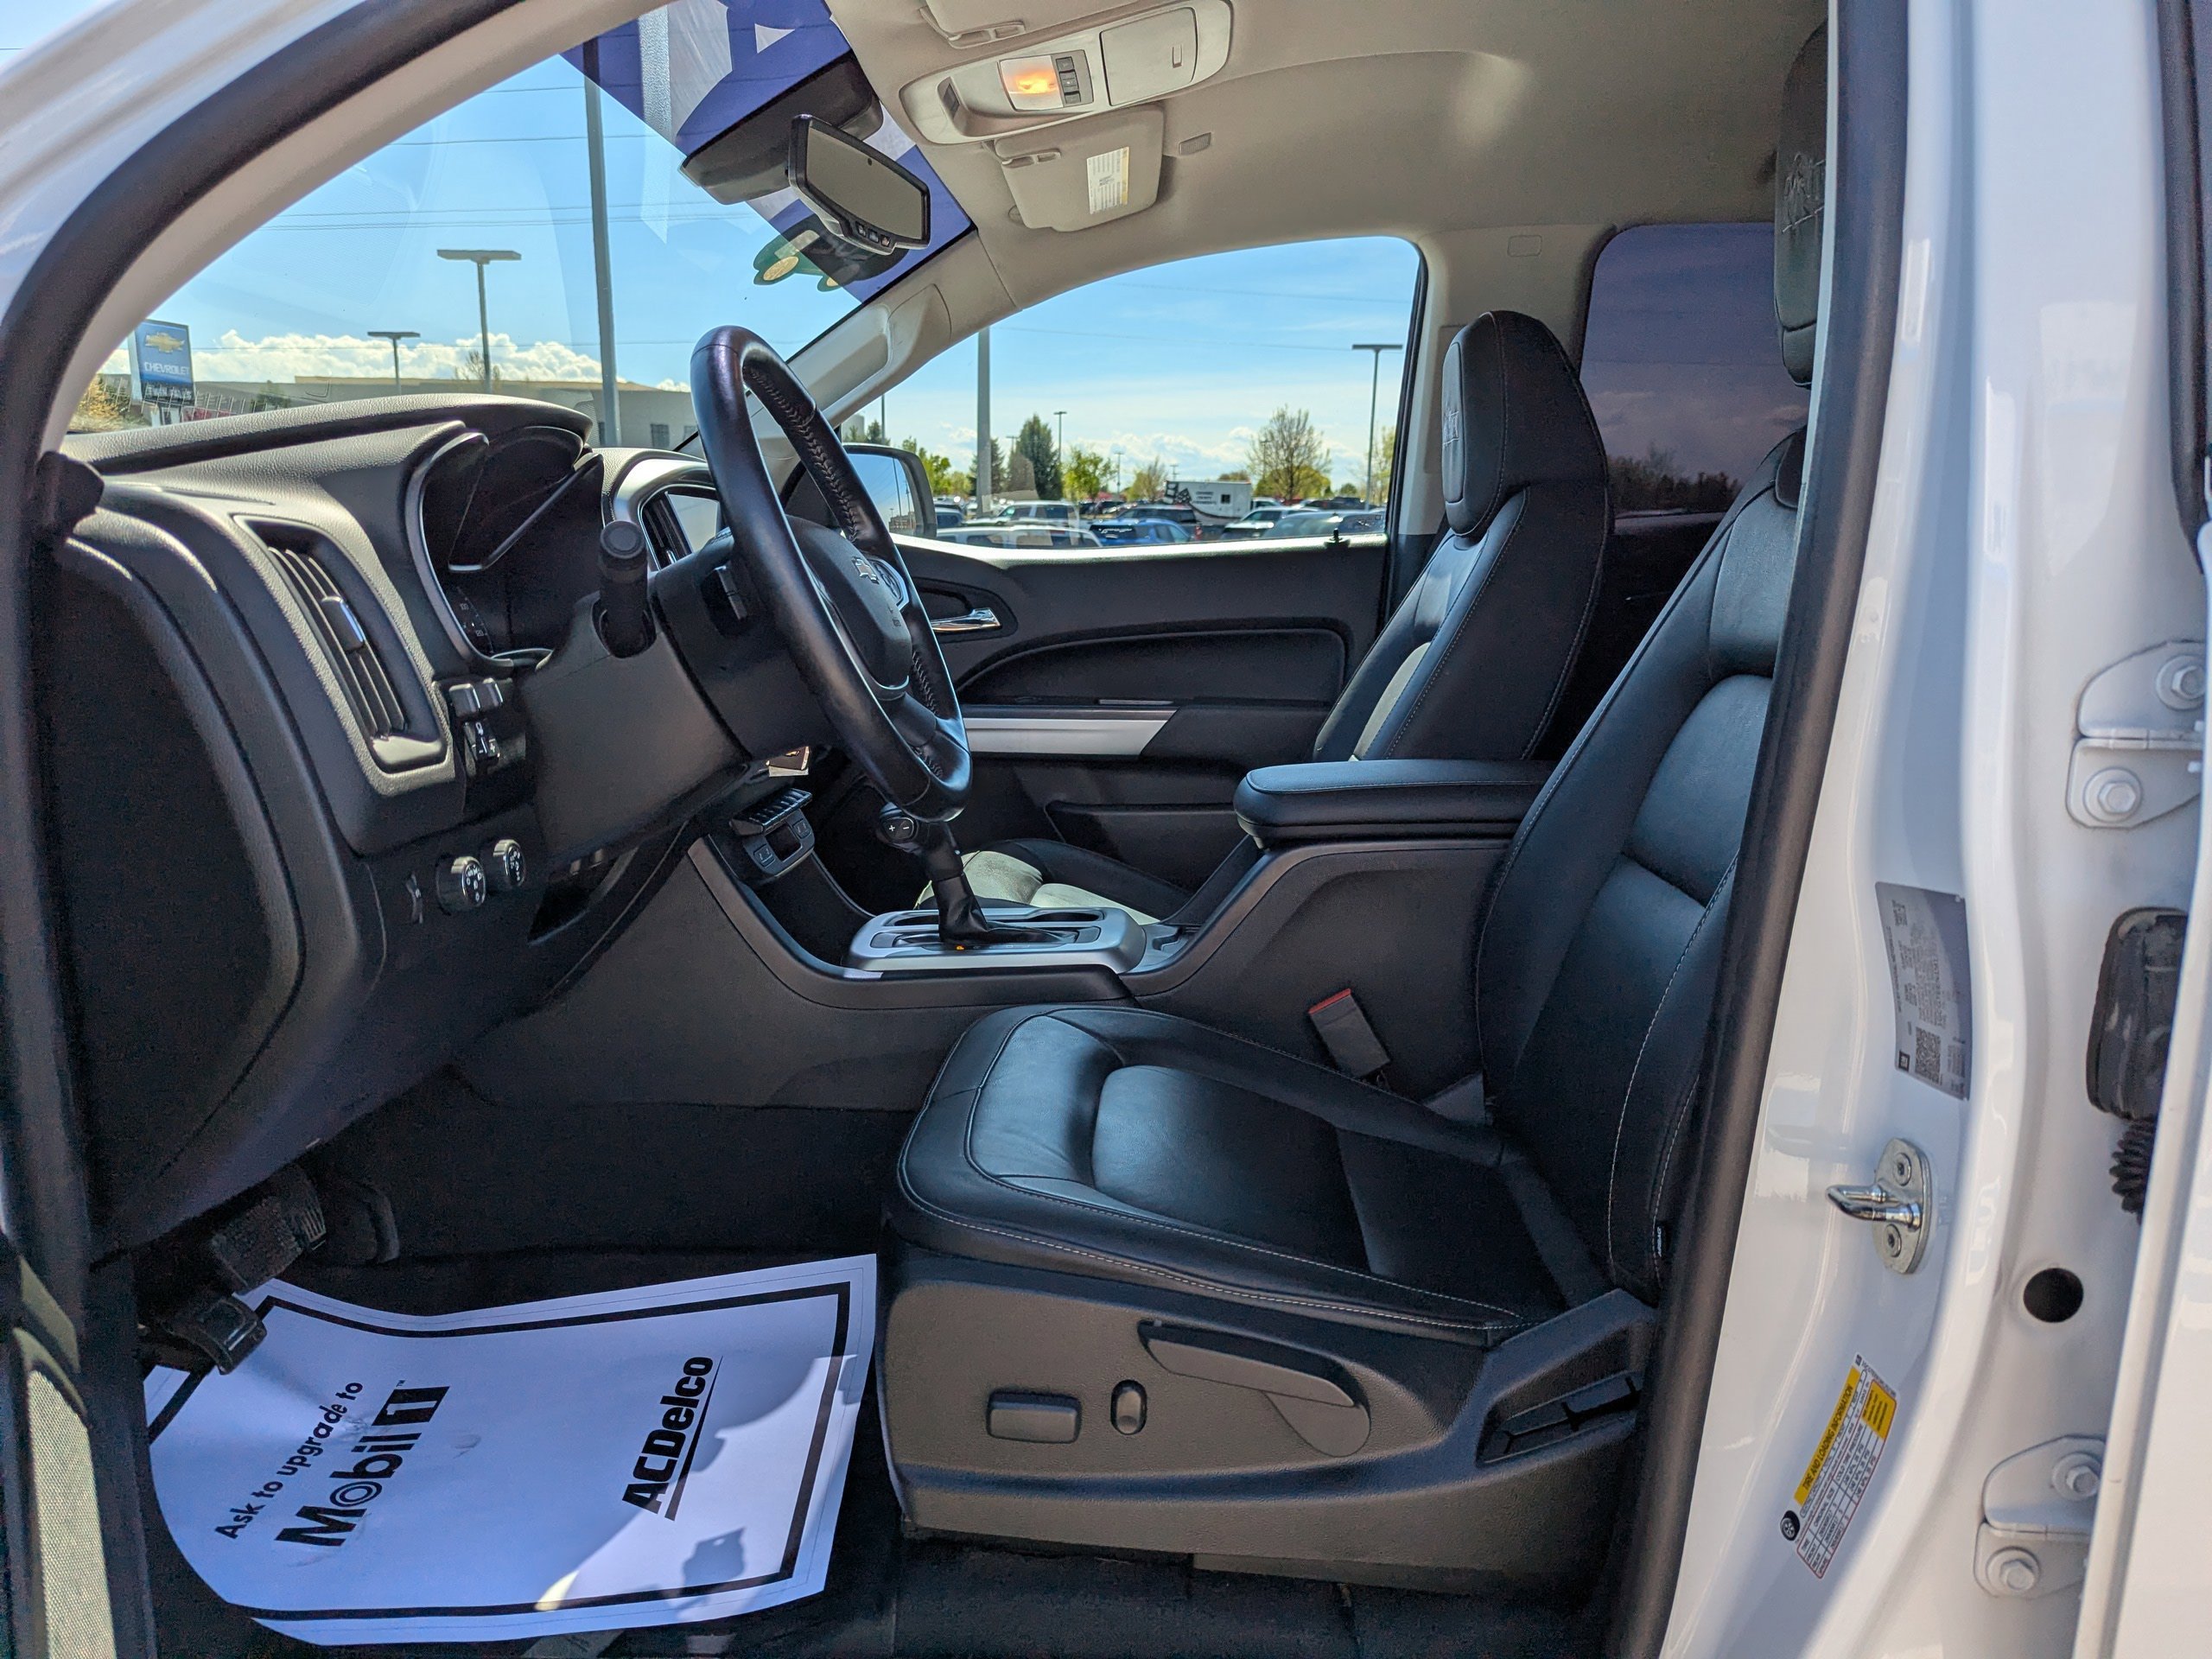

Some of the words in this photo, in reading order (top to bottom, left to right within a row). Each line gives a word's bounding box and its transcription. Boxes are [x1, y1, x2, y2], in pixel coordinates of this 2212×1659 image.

[143, 361, 190, 376] CHEVROLET
[215, 1503, 266, 1540] Ask
[251, 1481, 283, 1498] to
[276, 1404, 348, 1477] upgrade
[336, 1382, 363, 1401] to
[274, 1433, 423, 1547] Mobil
[622, 1357, 713, 1514] ACDelco
[1802, 1473, 1811, 1490] TIRE
[1811, 1459, 1820, 1474] AND
[1819, 1429, 1834, 1460] LOADING
[1831, 1386, 1853, 1428] INFORMATION
